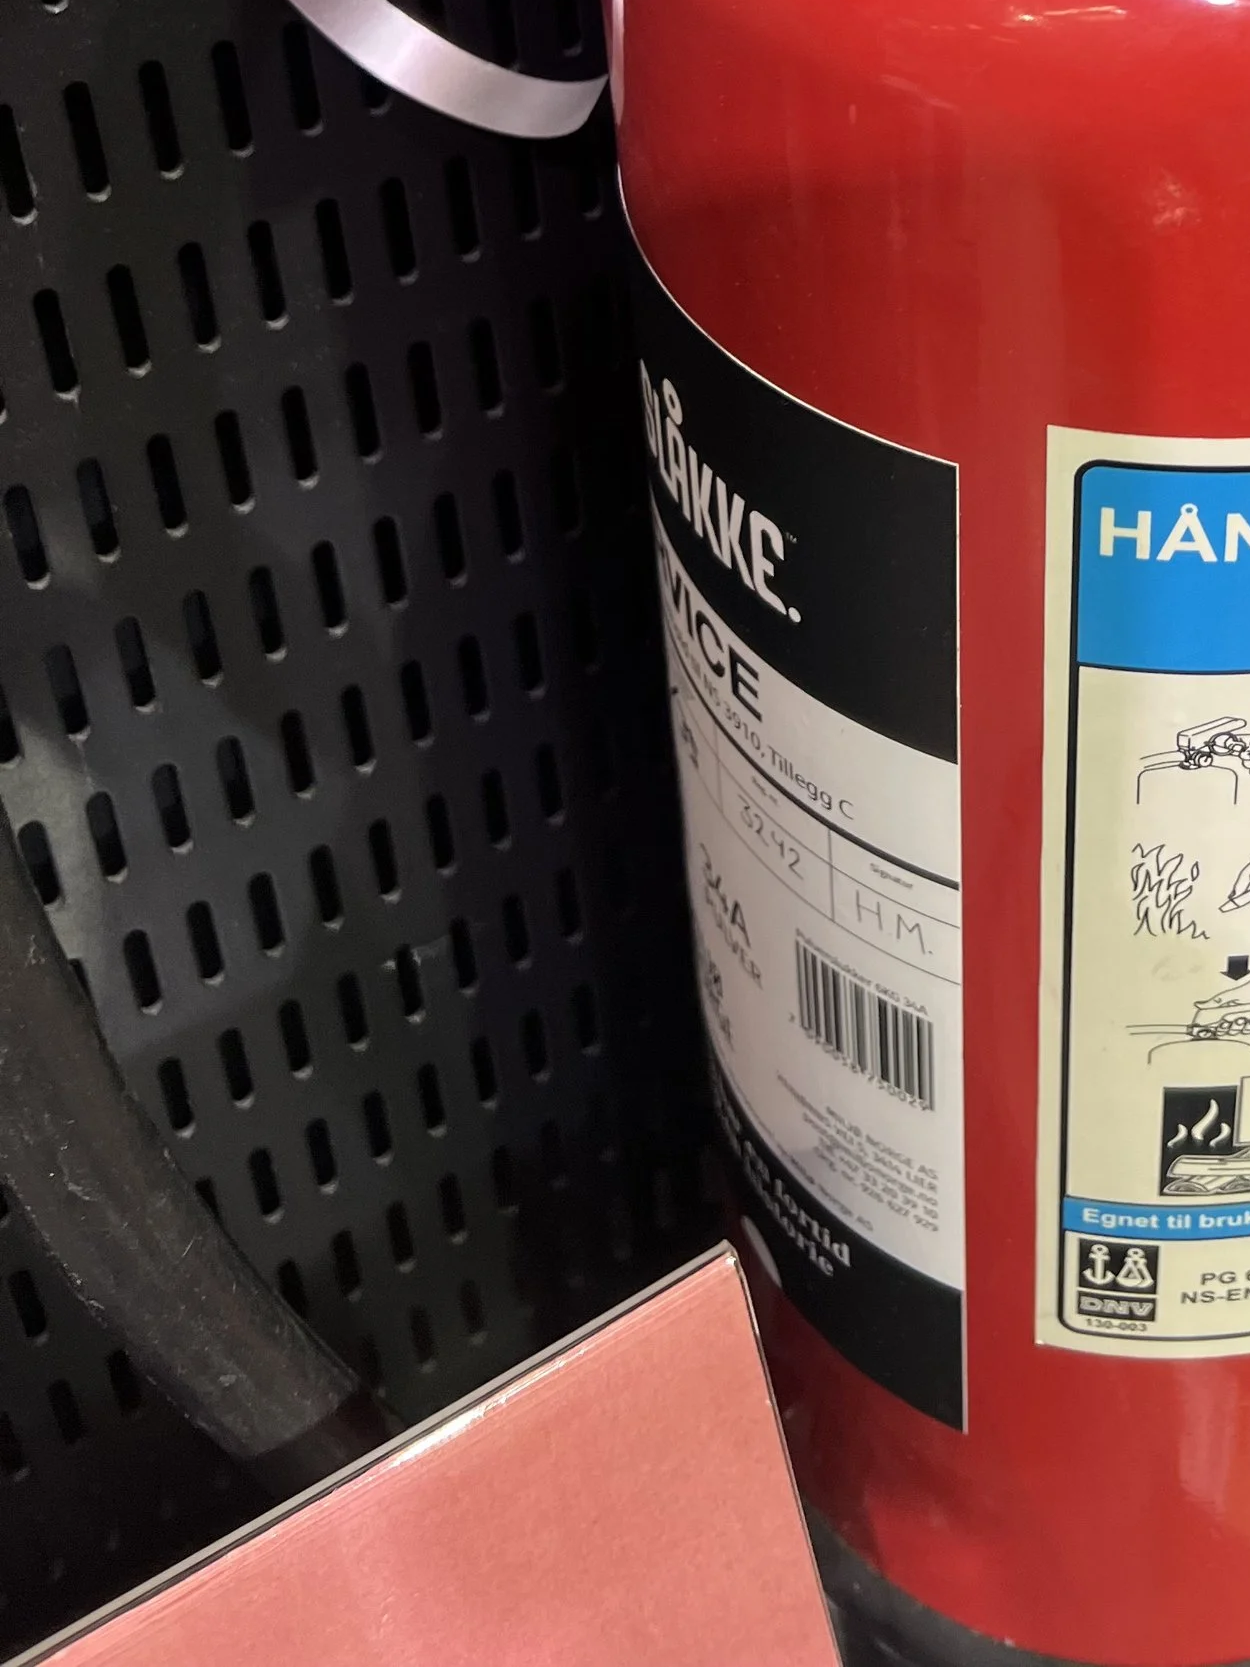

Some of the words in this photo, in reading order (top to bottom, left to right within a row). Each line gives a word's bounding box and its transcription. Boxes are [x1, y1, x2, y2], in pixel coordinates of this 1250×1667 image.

[763, 745, 832, 809] Tillegg
[839, 799, 855, 821] C
[1082, 1207, 1160, 1230] Egnet
[1166, 1213, 1191, 1230] til
[1200, 1270, 1236, 1285] PG
[1080, 1296, 1153, 1317] DNV
